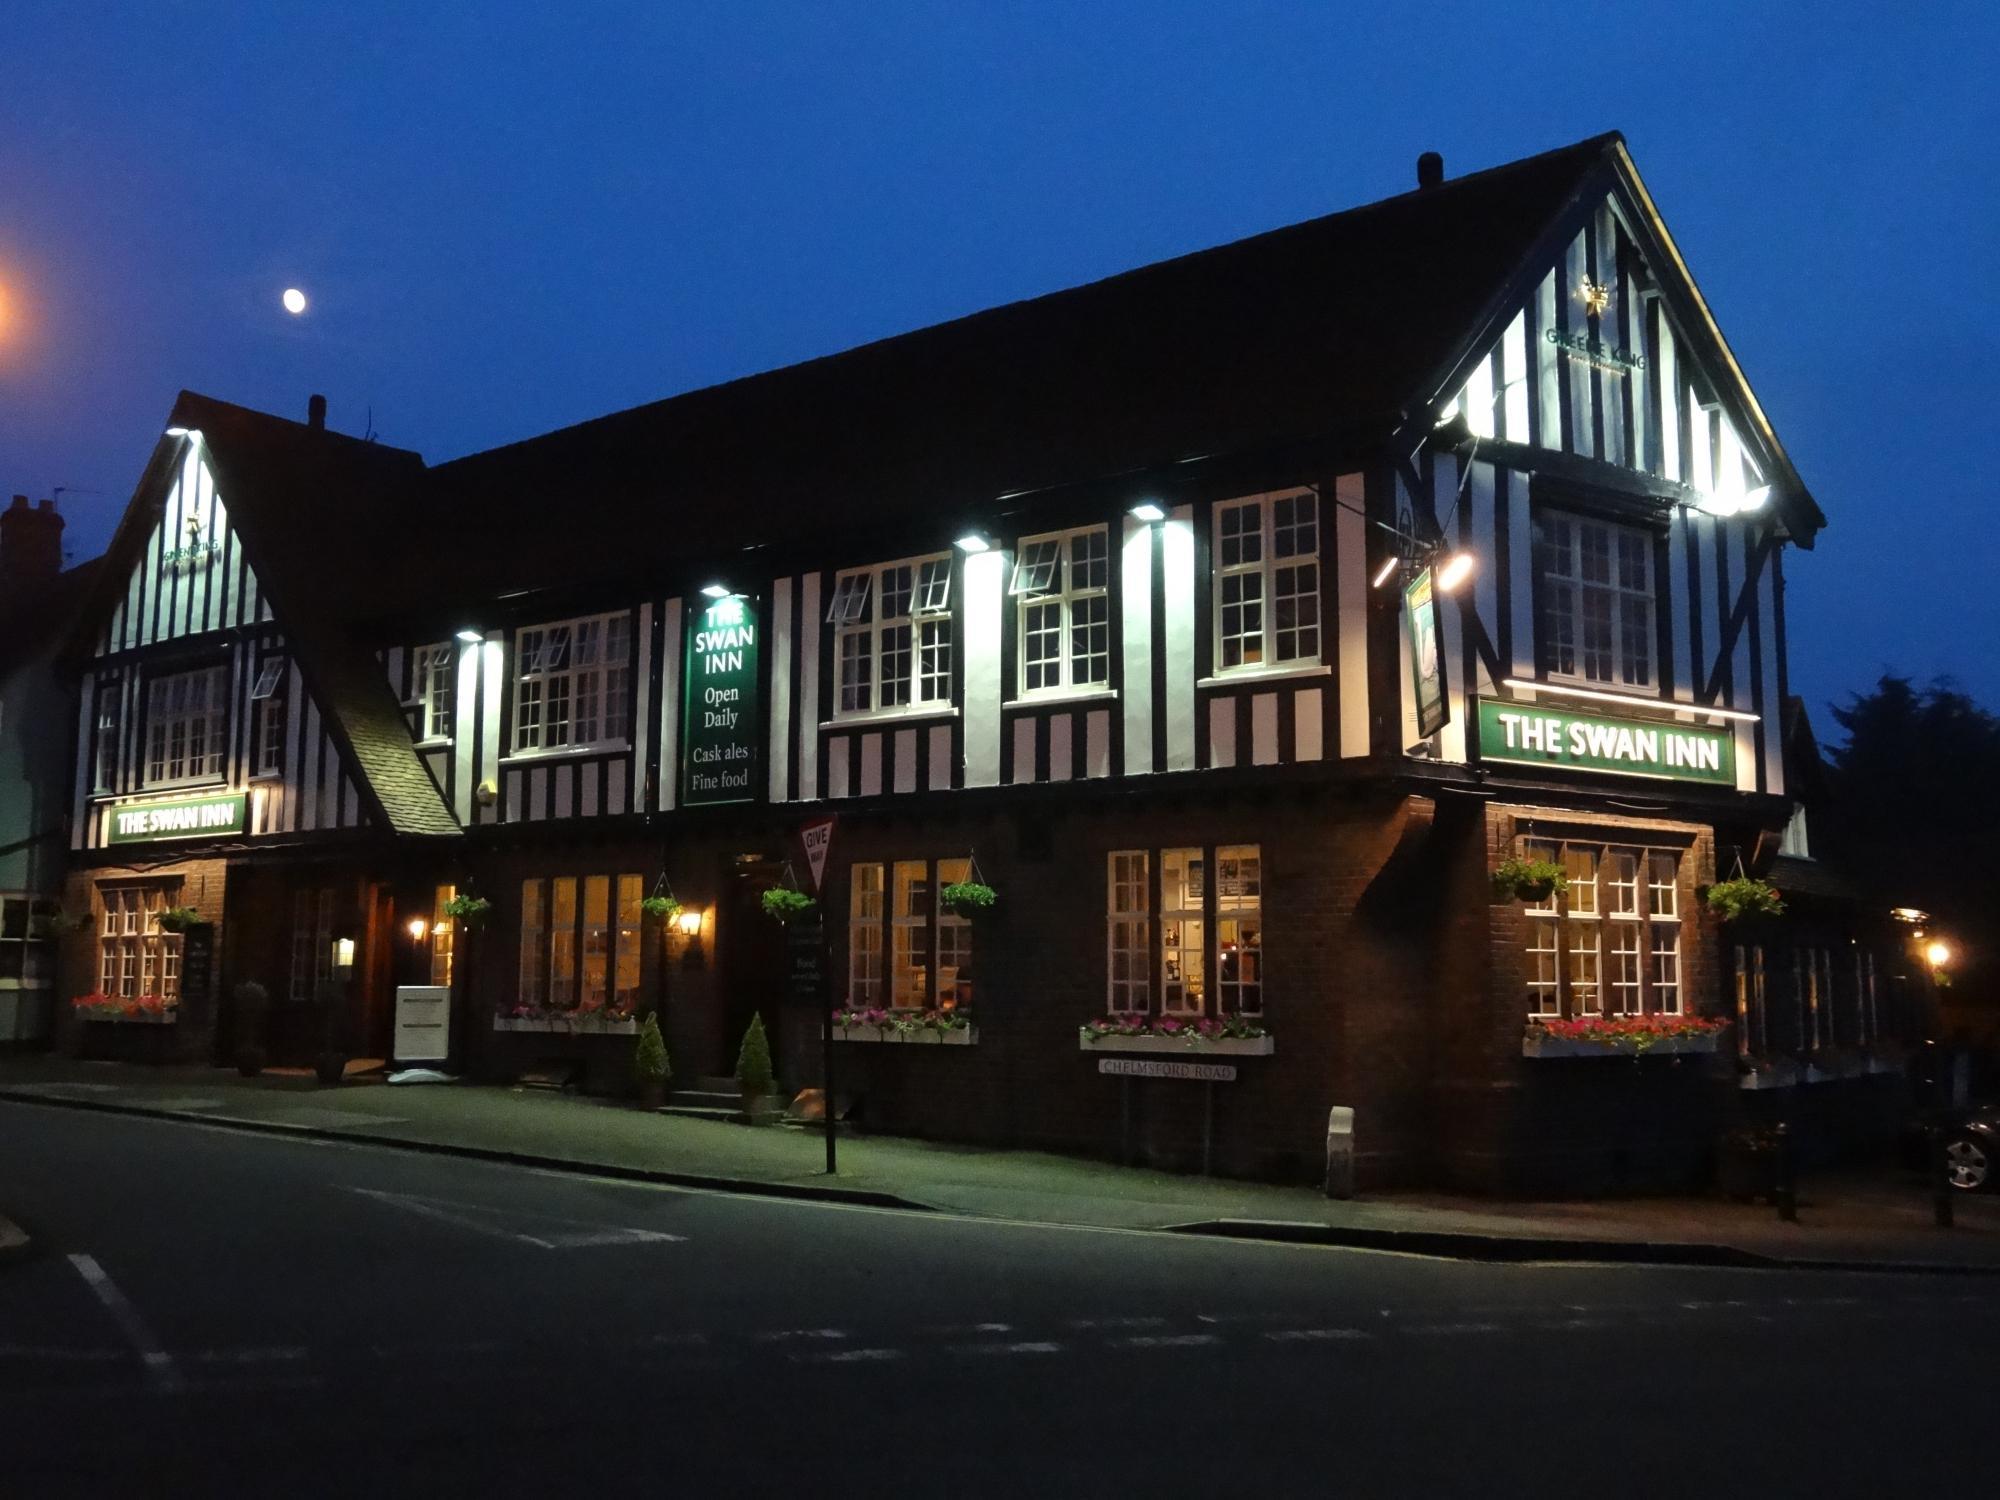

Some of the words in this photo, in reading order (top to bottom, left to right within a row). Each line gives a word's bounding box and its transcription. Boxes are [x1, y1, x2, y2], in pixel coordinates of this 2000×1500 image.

[706, 602, 744, 628] THE
[695, 625, 754, 653] SWAN
[705, 650, 743, 674] INN
[705, 687, 739, 707] Open
[704, 707, 739, 730] Daily
[693, 744, 722, 763] Cask
[724, 742, 749, 761] ales
[1498, 713, 1563, 753] THE
[1567, 721, 1658, 762] SWAN
[1665, 733, 1719, 770] INN
[692, 773, 718, 790] Fine
[721, 768, 748, 788] food
[117, 810, 148, 835] THE
[149, 806, 199, 832] SWAN
[201, 803, 235, 827] INN
[806, 826, 828, 848] GIVE
[1103, 1060, 1189, 1077] CHELMSFORD
[1194, 1065, 1232, 1079] ROAD
